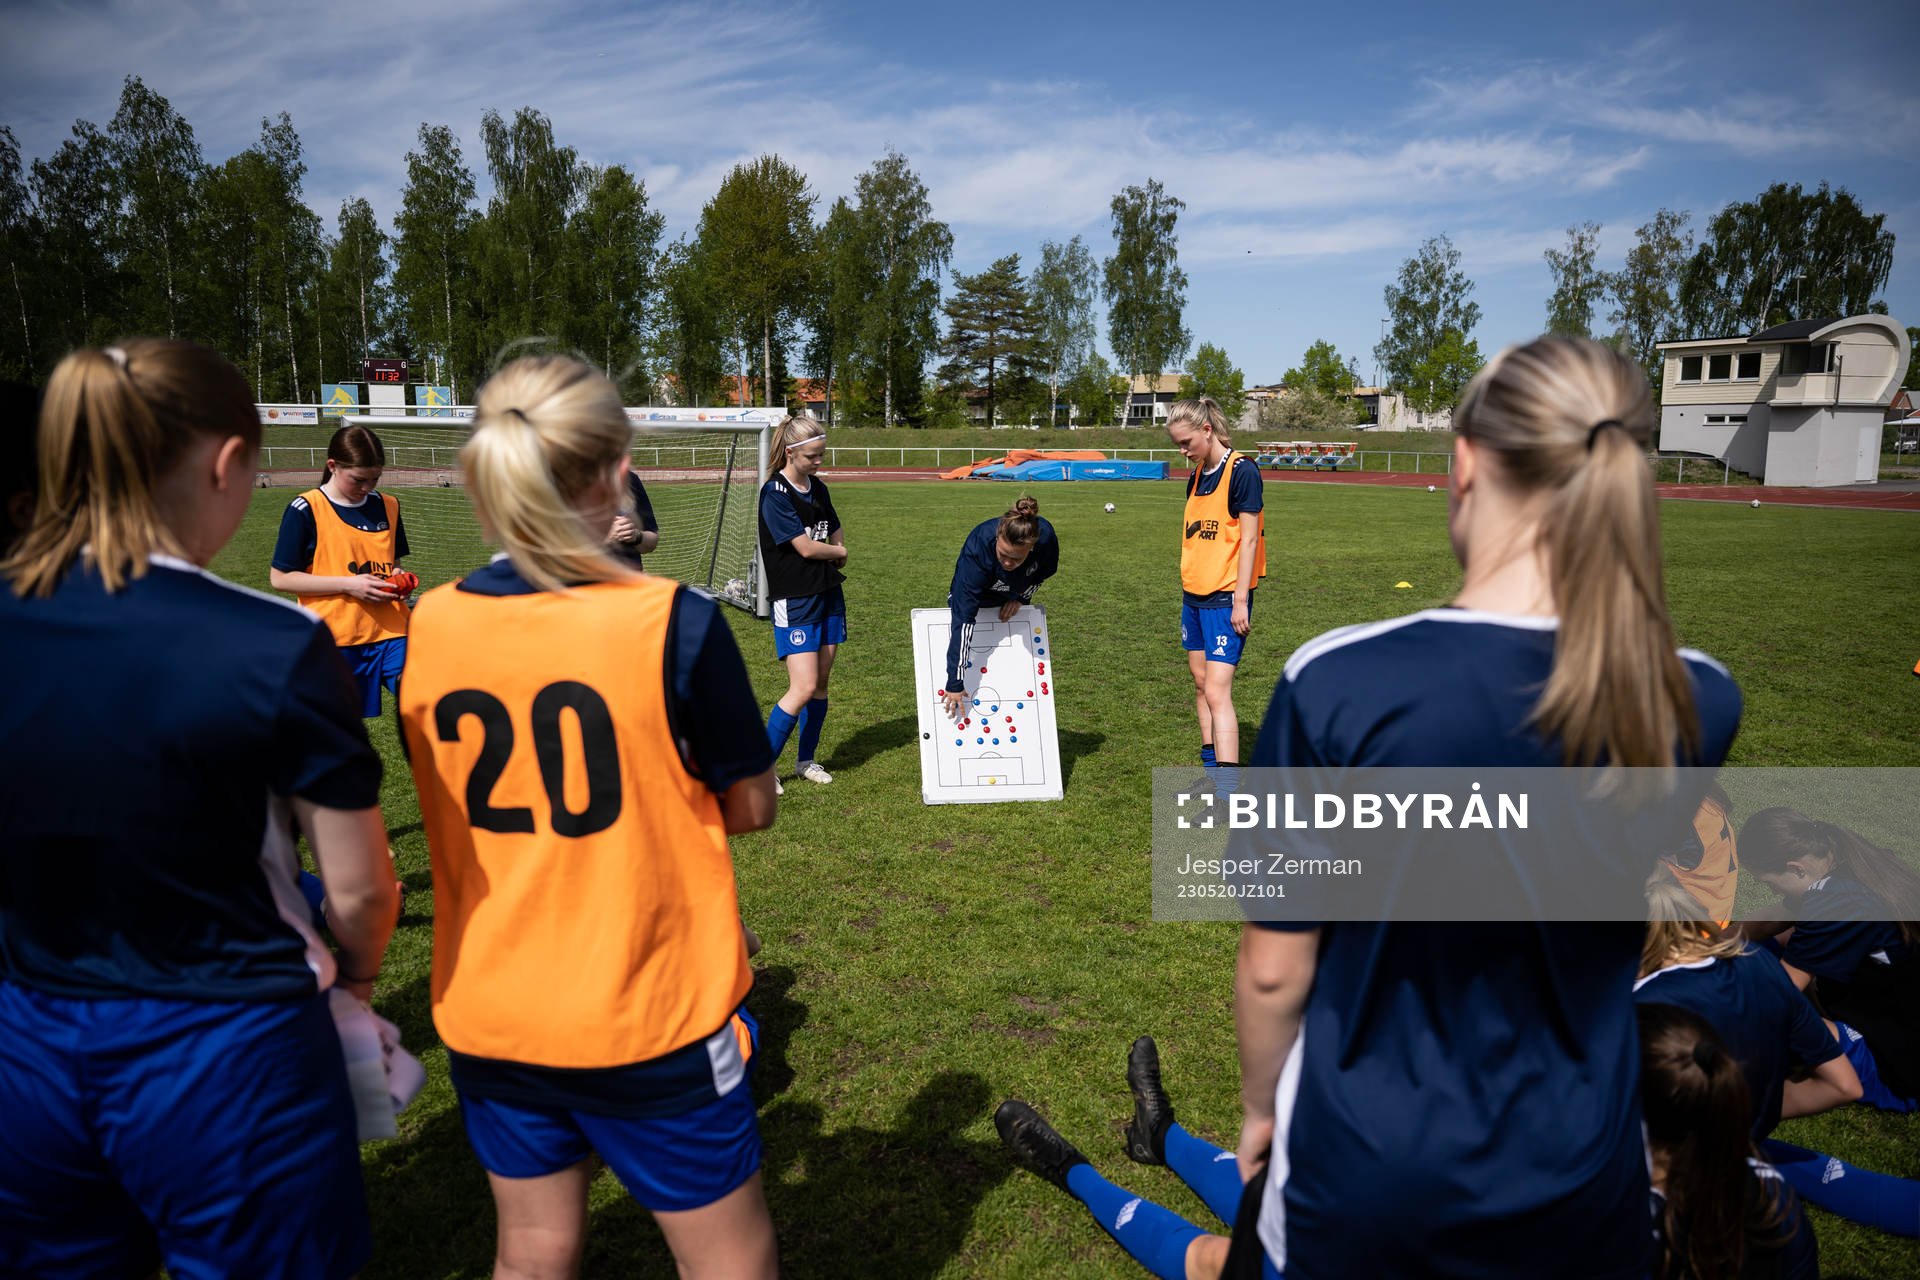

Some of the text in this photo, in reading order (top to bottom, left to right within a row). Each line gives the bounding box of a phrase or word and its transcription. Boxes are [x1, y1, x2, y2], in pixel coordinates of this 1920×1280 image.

[401, 361, 407, 369] G
[375, 371, 400, 382] 11:32
[1216, 635, 1228, 646] 13
[434, 680, 623, 839] 20
